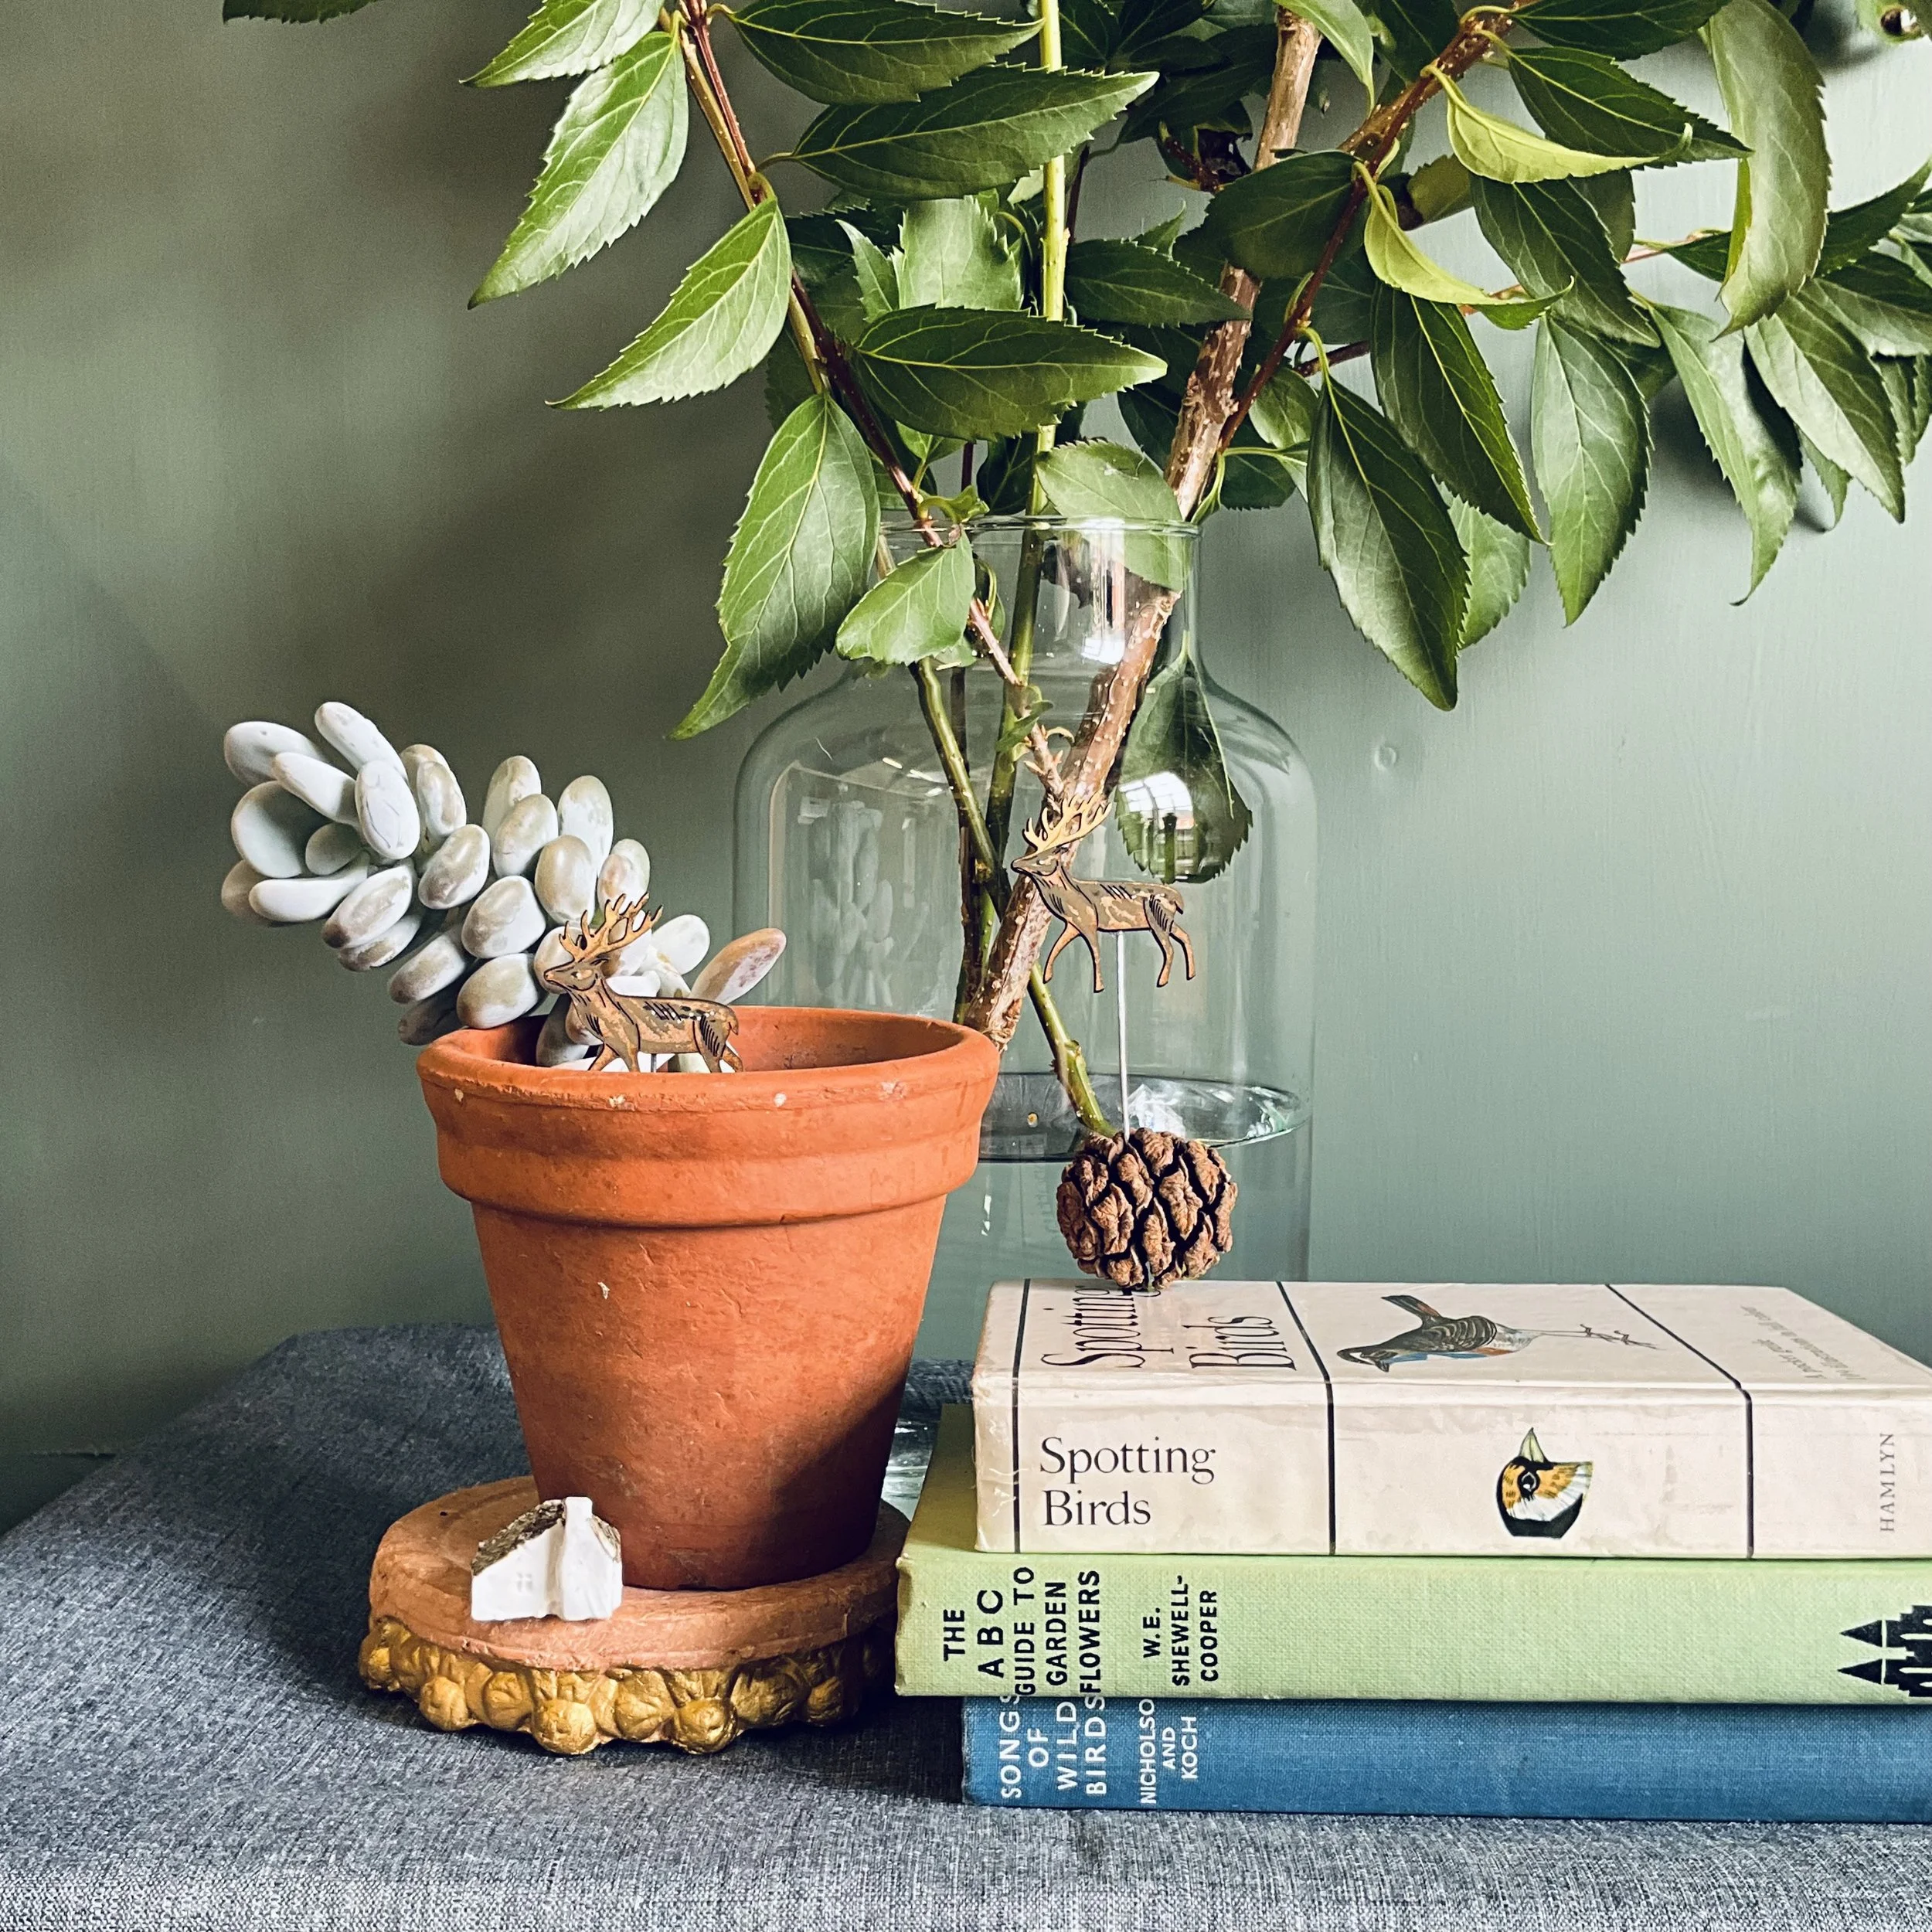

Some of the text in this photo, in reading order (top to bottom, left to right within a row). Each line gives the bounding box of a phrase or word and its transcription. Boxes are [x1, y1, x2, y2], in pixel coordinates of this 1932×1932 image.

[1040, 1285, 1175, 1369] Spotting
[1182, 1316, 1297, 1371] Birds
[1040, 1436, 1216, 1485] Spotting
[1879, 1433, 1895, 1532] HAMLYN
[1042, 1489, 1151, 1526] Birds
[943, 1609, 966, 1662] THE
[1012, 1566, 1036, 1696] GUIDE TO
[1044, 1582, 1068, 1686] GARDEN
[1077, 1570, 1101, 1693] FLOWERS
[1142, 1607, 1161, 1658] W.E.
[1171, 1575, 1190, 1686] SHEWELL-
[1199, 1590, 1219, 1682] COOPER
[1027, 1728, 1049, 1767] OF
[1056, 1701, 1078, 1791] WILD
[1083, 1695, 1107, 1795] BIRDS
[1138, 1699, 1157, 1804] NICHOLSO
[1162, 1726, 1176, 1770] AND
[1180, 1716, 1199, 1779] KOCH
